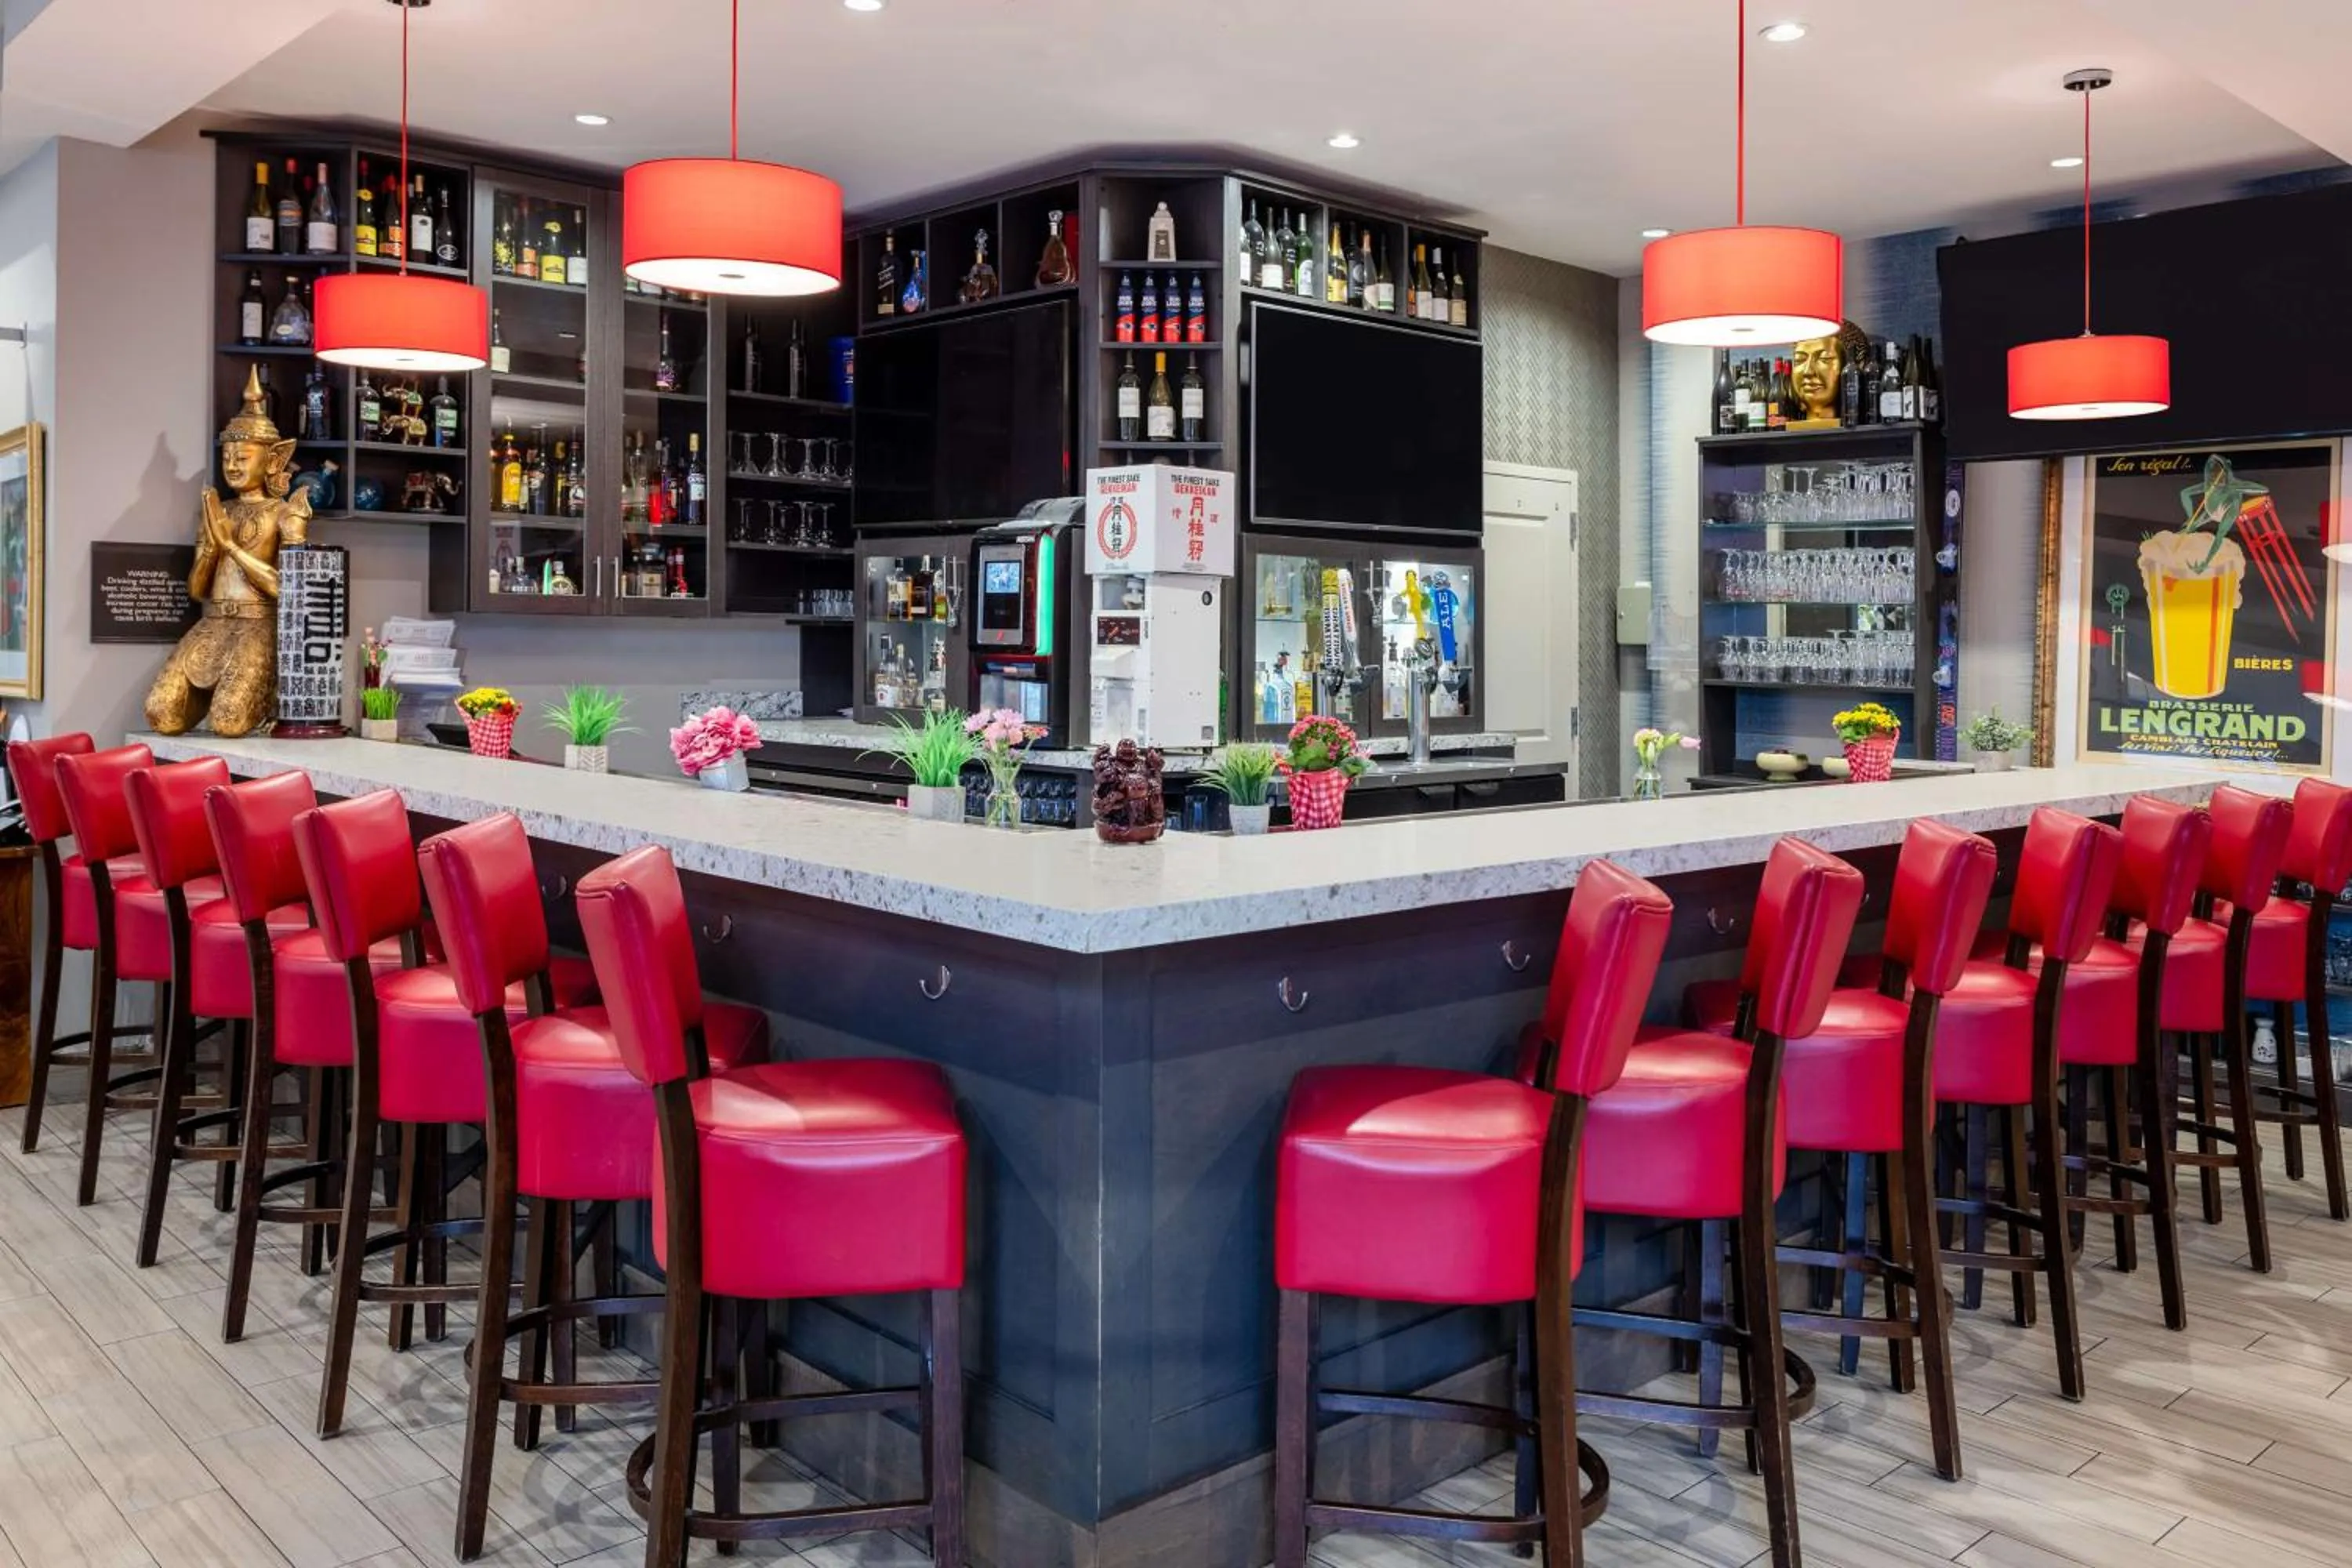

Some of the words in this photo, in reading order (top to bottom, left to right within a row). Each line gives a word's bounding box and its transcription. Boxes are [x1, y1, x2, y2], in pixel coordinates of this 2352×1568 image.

[1108, 474, 1125, 484] FINEST
[1127, 473, 1141, 482] SAKE
[1171, 474, 1182, 483] THE
[1184, 476, 1203, 485] FINEST
[107, 576, 137, 586] Drinking
[1439, 592, 1451, 630] ALE
[2148, 699, 2255, 713] BRASSERIE
[2100, 707, 2306, 742] LENGRAND
